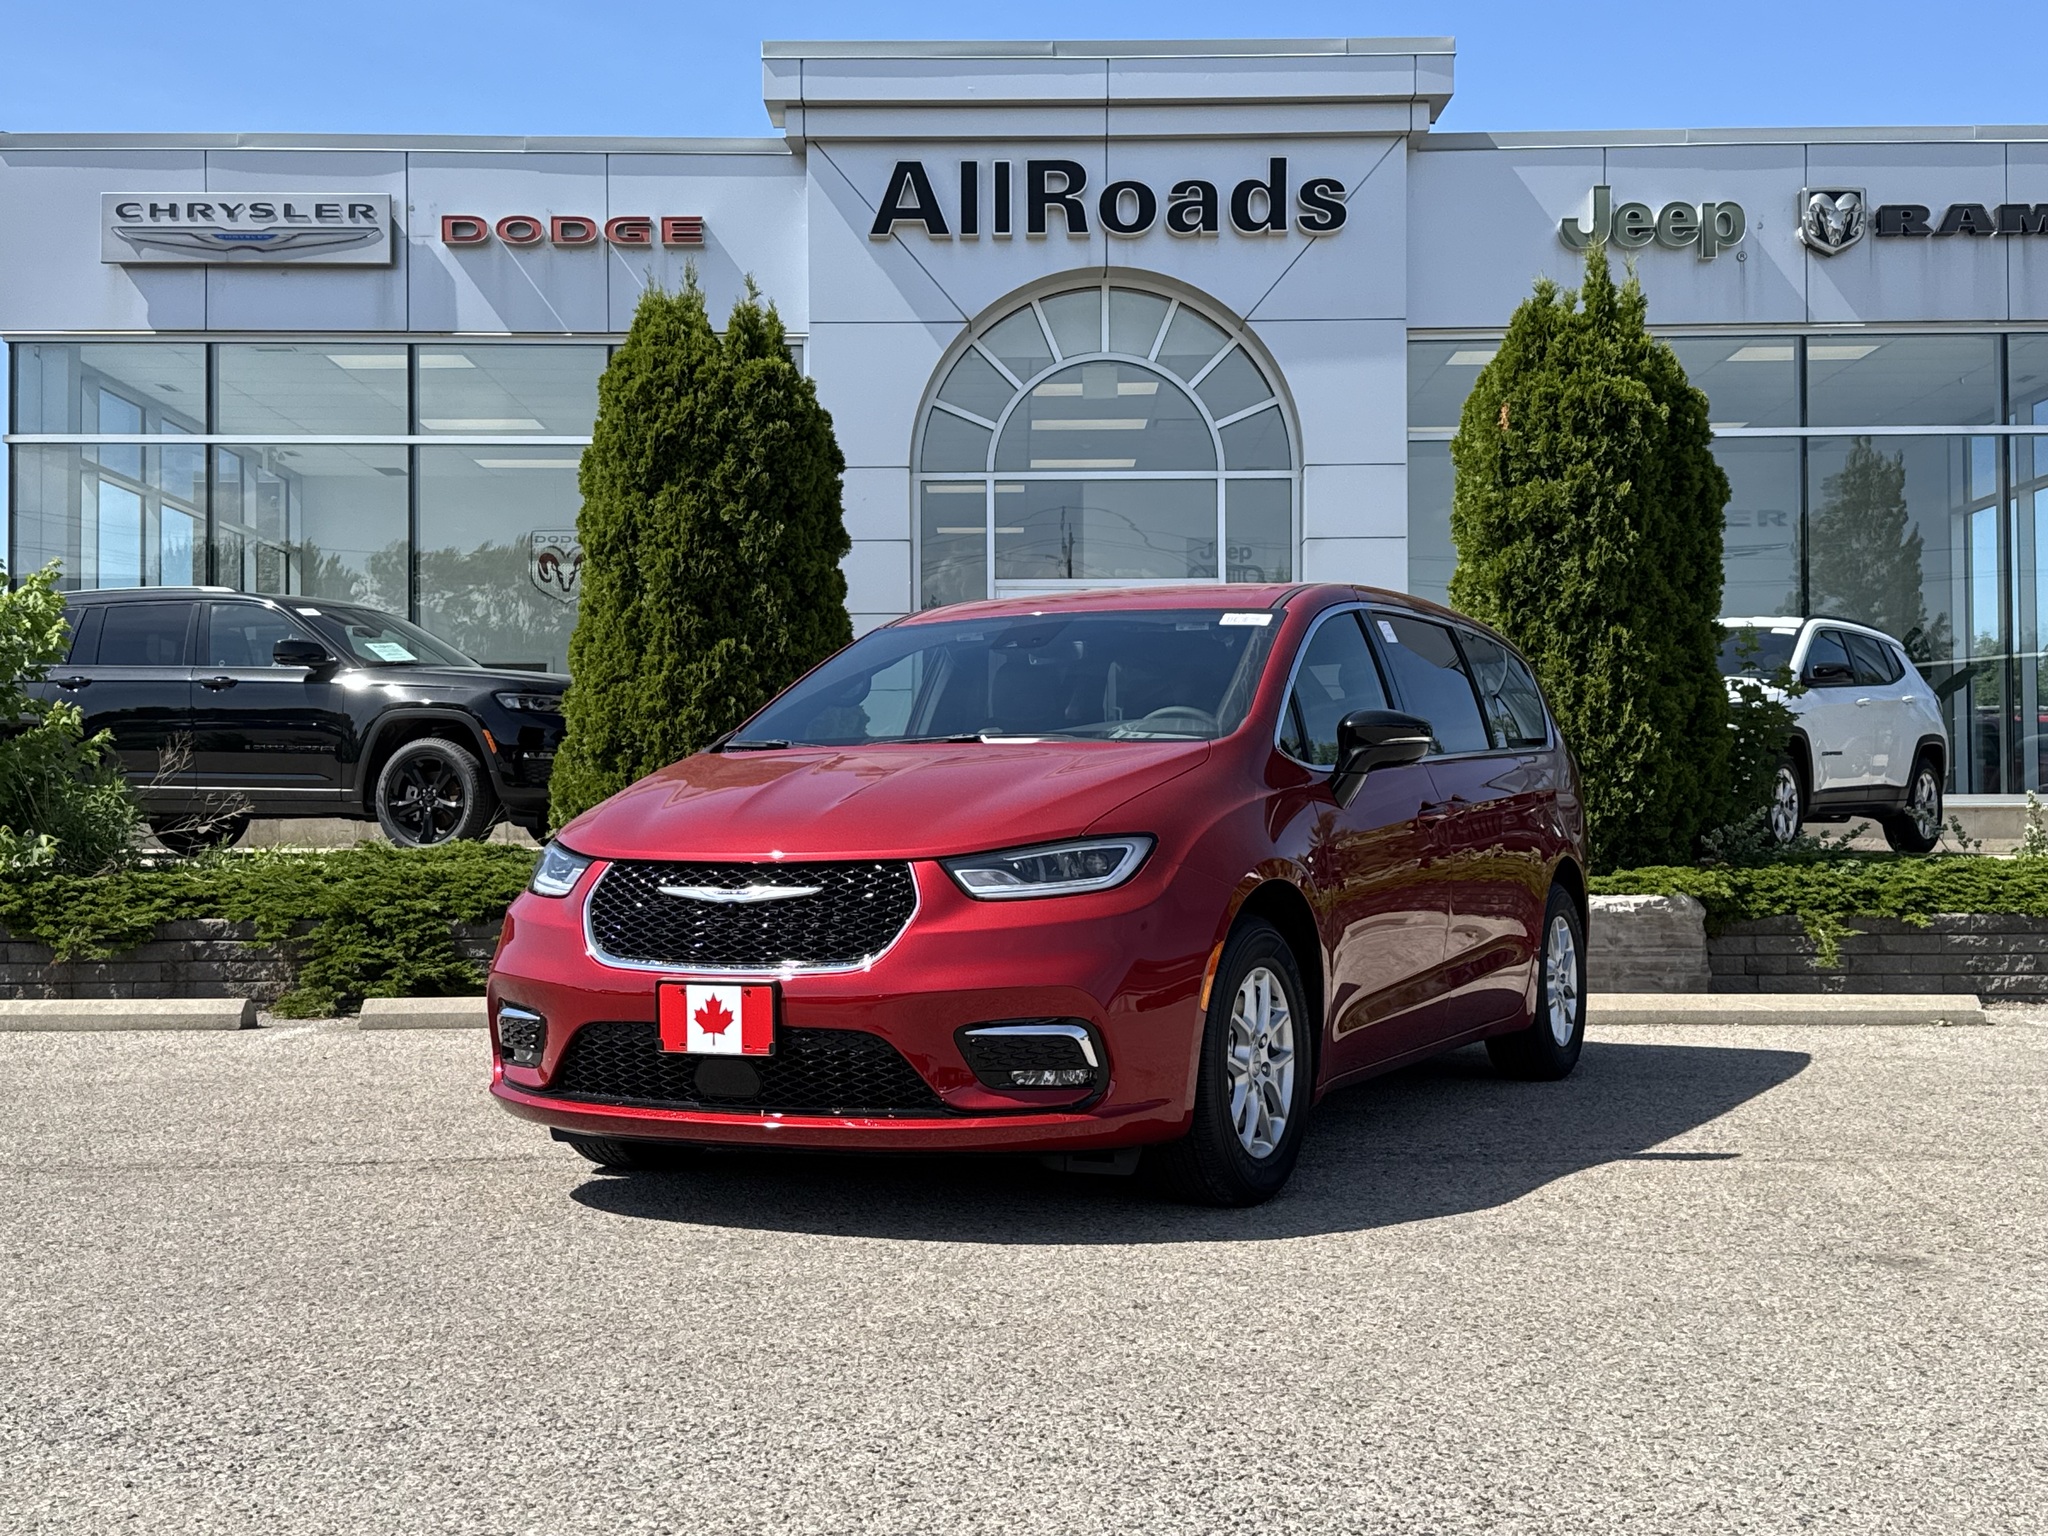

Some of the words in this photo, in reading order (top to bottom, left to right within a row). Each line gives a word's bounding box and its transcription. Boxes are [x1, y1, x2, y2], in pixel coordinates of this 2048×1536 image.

[115, 202, 377, 221] CHRYSLER
[868, 155, 1348, 239] AllRoads
[441, 215, 704, 247] DODGE
[1558, 184, 1747, 260] Jeep
[1875, 203, 2048, 237] RAM
[1200, 541, 1252, 564] Jep
